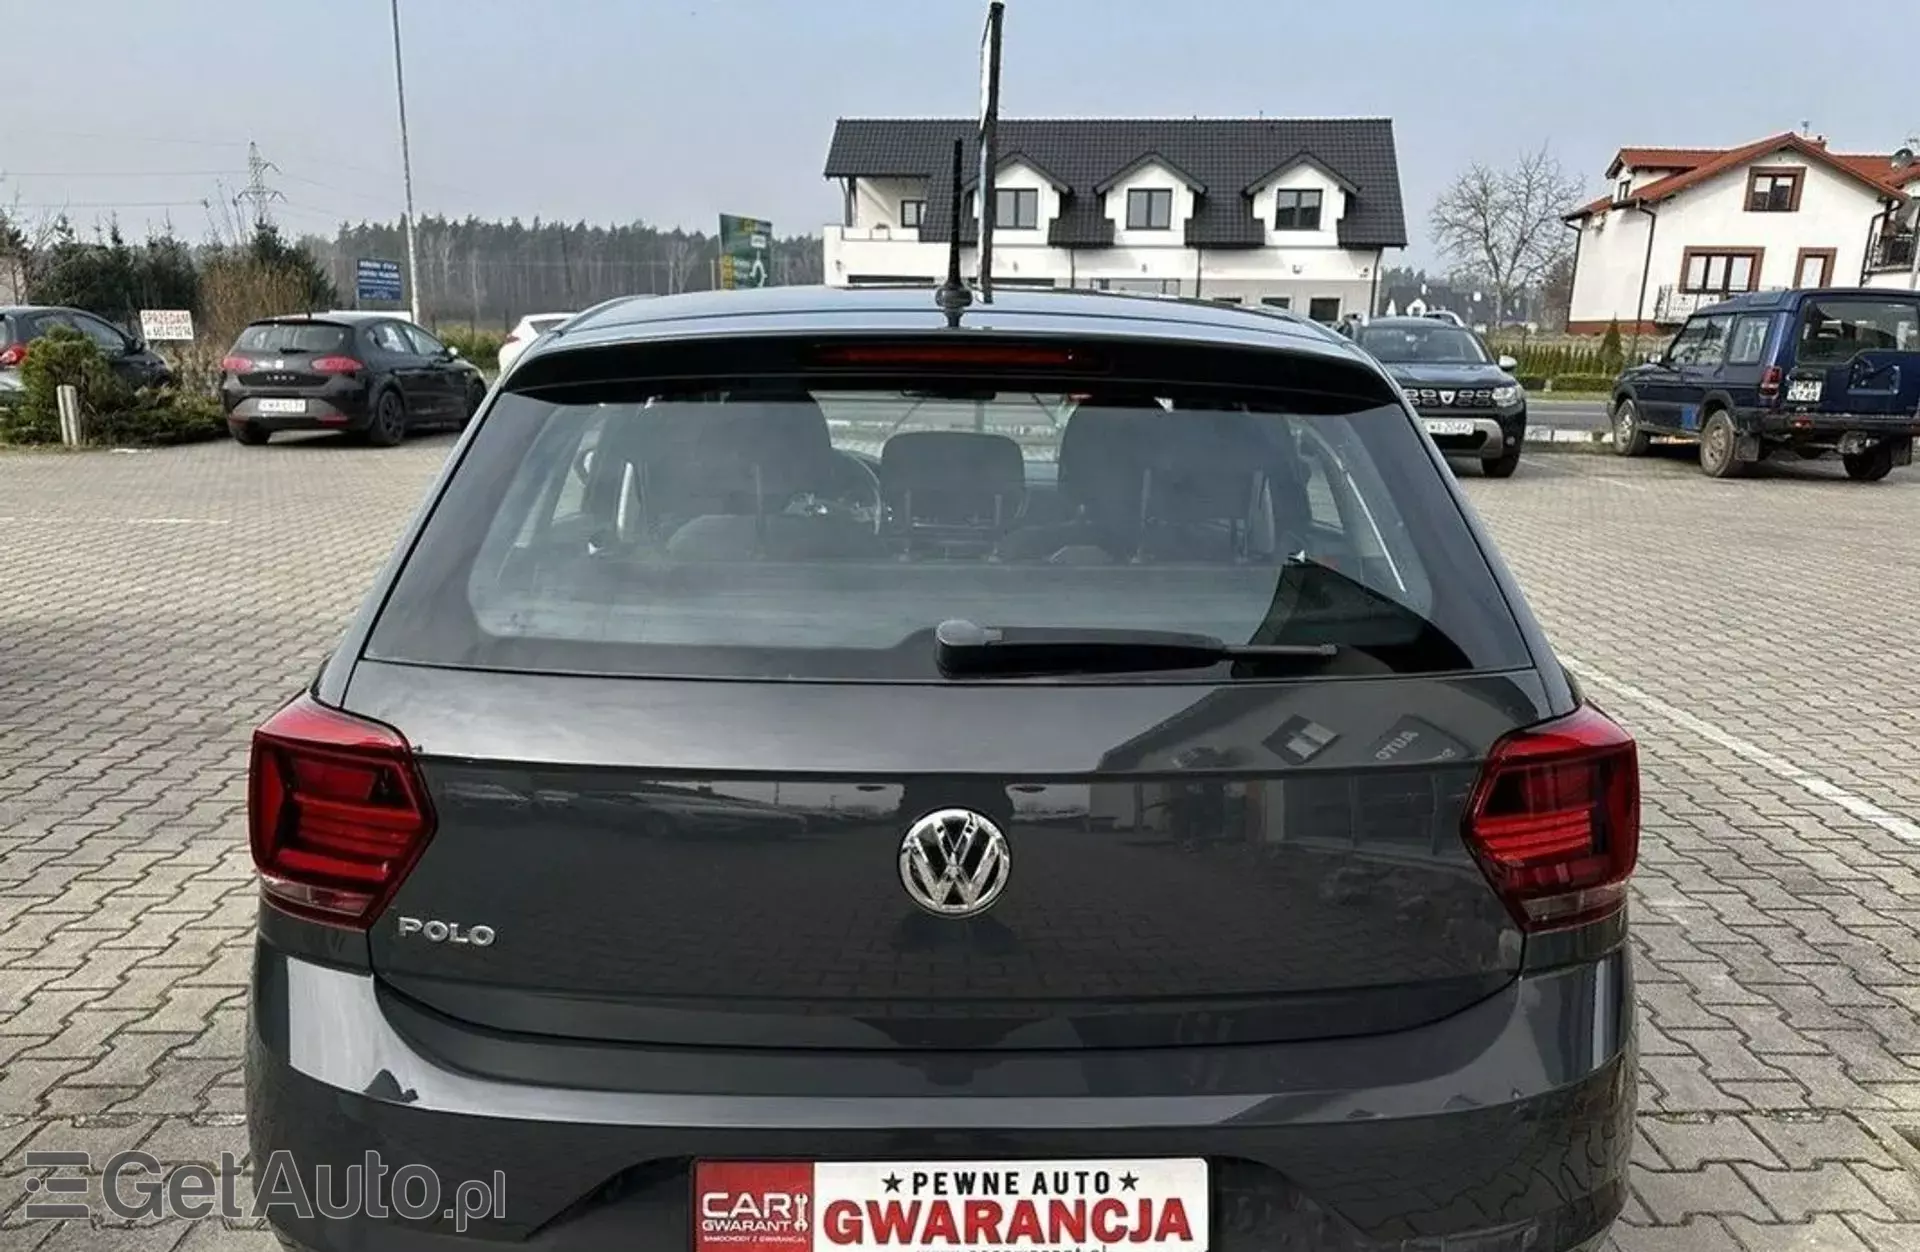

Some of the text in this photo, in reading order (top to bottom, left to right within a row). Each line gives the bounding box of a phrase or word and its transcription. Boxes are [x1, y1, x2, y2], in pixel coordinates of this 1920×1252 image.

[900, 808, 1011, 914] VW
[398, 916, 496, 947] POLO
[912, 1170, 1111, 1196] PEWNE AUTO
[702, 1192, 792, 1218] CAR
[702, 1220, 792, 1232] GWARANT
[822, 1198, 1194, 1245] GWARANCJA
